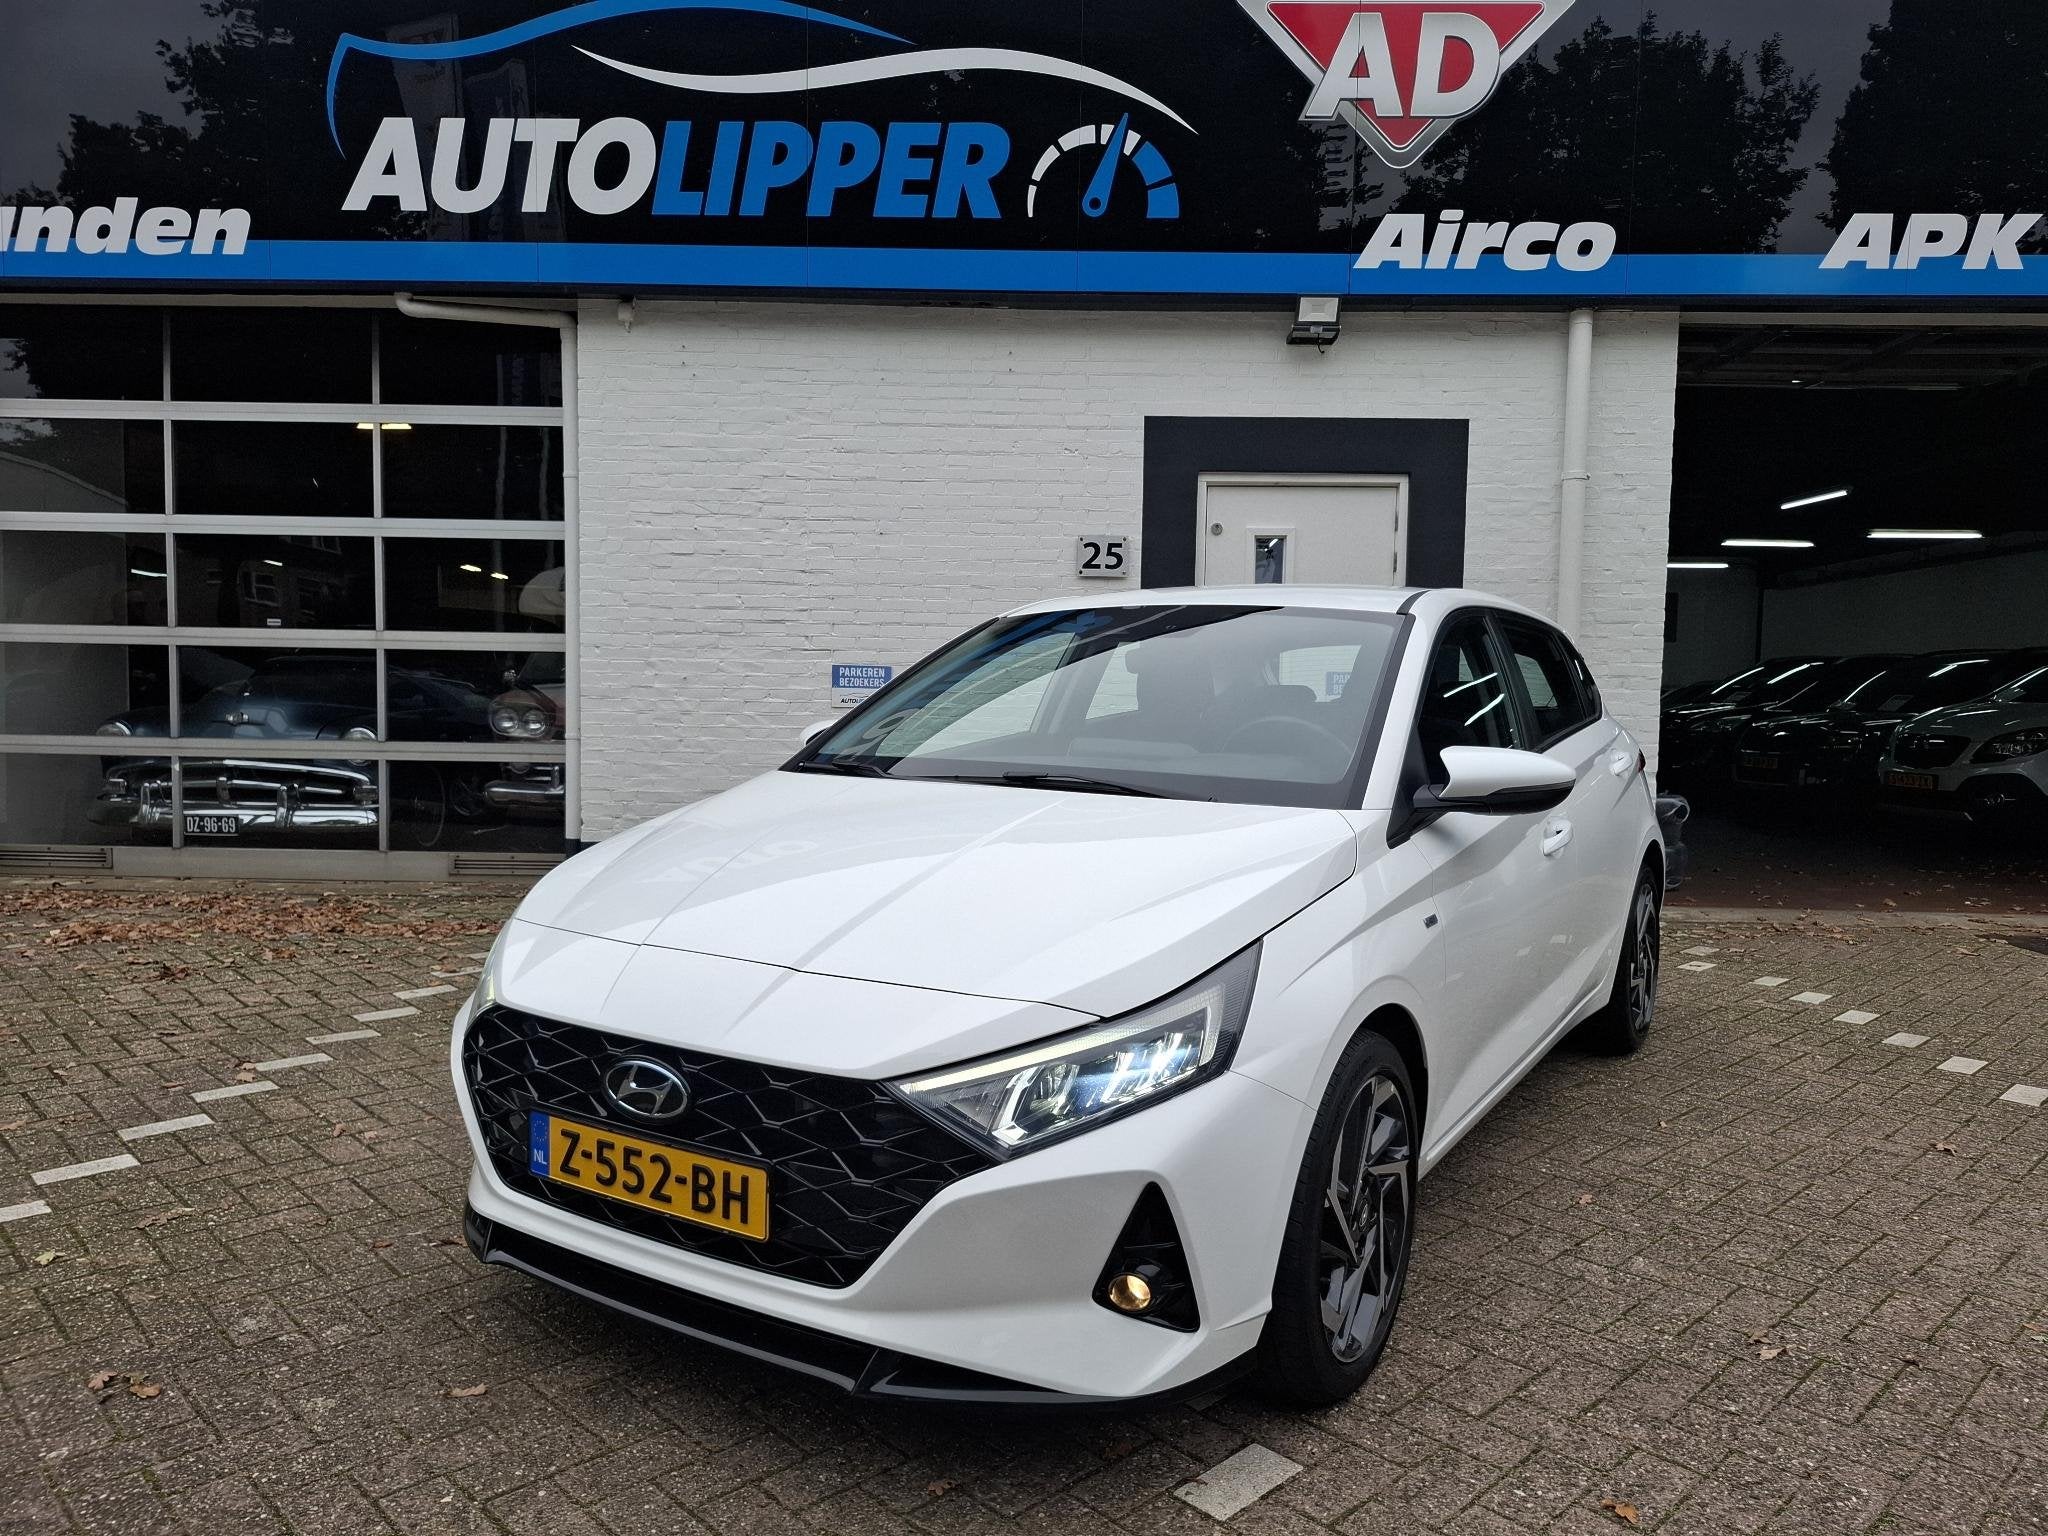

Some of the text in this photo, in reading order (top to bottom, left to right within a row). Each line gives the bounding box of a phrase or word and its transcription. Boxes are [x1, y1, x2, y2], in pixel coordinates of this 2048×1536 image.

[1304, 12, 1501, 117] AD
[1353, 209, 1616, 272] Airco
[1818, 213, 2043, 270] APK
[1082, 542, 1124, 570] 25
[839, 667, 885, 678] PARKEREN
[839, 678, 885, 687] BEZOEKERS
[186, 816, 236, 833] DZ-96-69
[533, 1149, 548, 1165] NL
[559, 1128, 750, 1225] Z-552-BH
